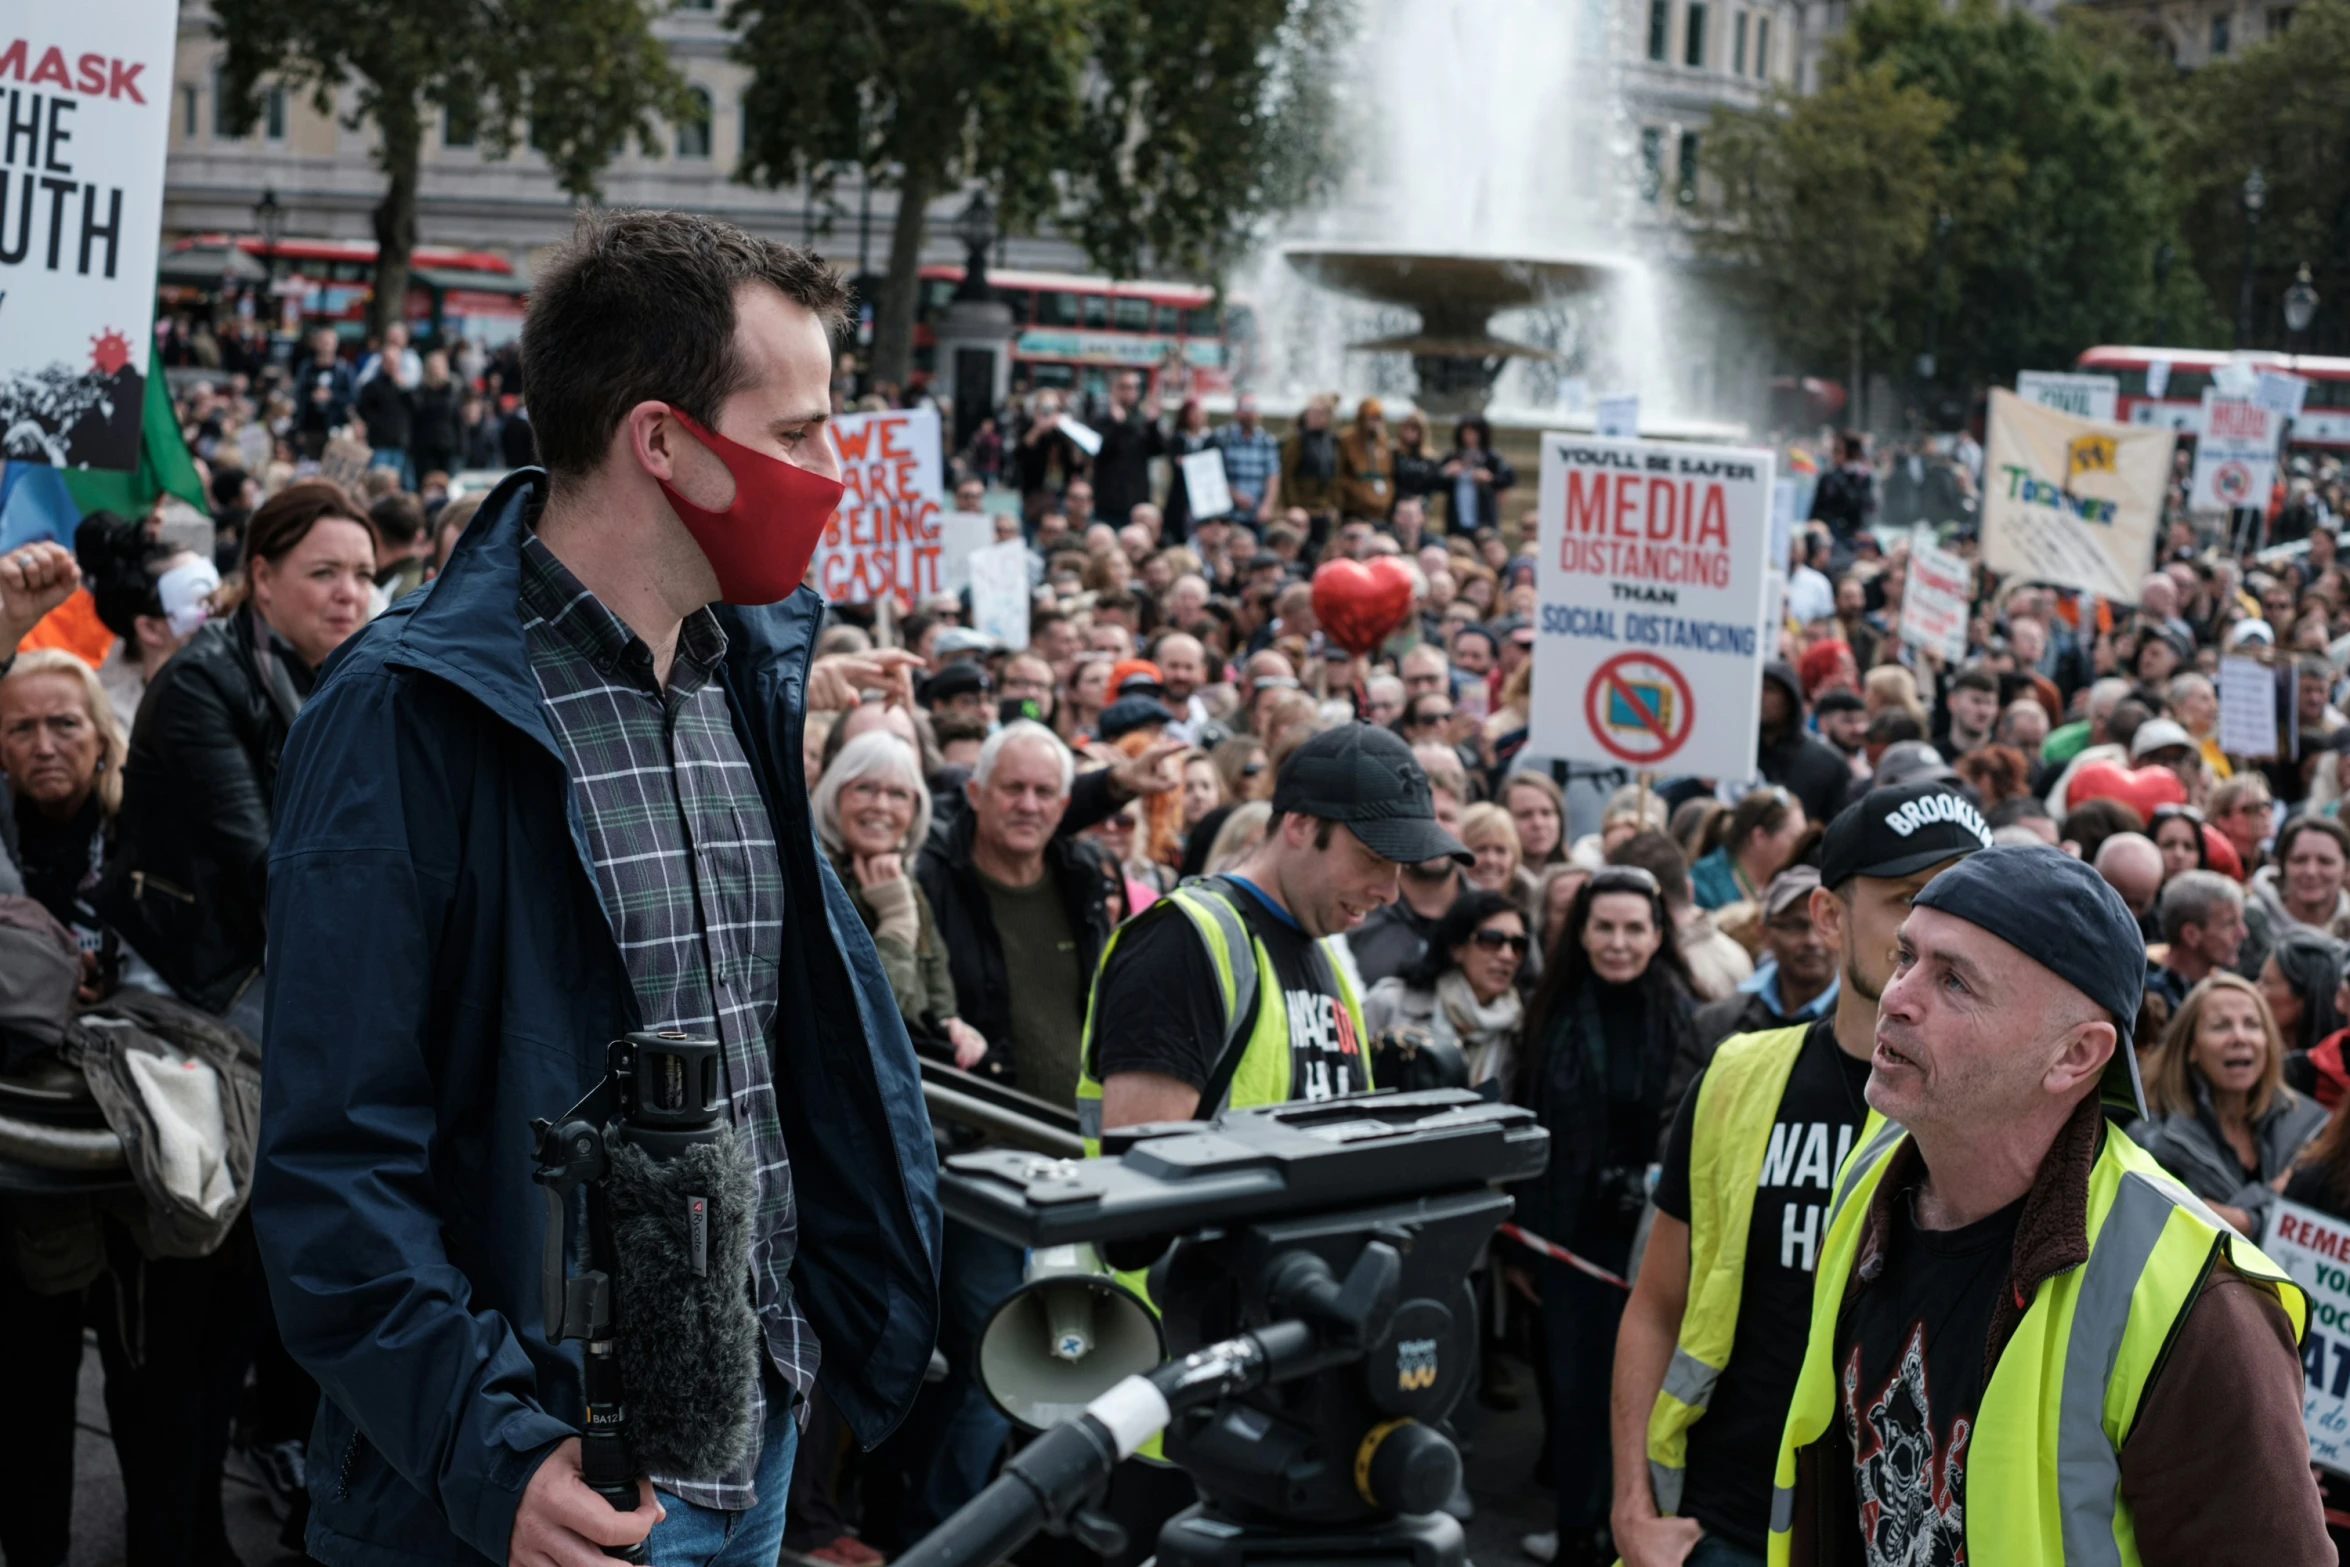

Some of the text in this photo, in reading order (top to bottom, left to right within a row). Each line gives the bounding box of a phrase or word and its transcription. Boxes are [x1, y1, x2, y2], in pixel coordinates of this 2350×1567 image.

[0, 87, 77, 174] HE
[830, 417, 911, 461] WE
[843, 460, 920, 500] ARE
[1646, 454, 1673, 472] BE
[1680, 459, 1756, 481] SAFER
[824, 501, 943, 548] BEING
[1565, 469, 1729, 549] MEDIA
[823, 545, 942, 600] GASLIT
[1560, 536, 1731, 590] DISTANCING
[1611, 583, 1678, 606] THAN
[1542, 604, 1757, 658] SOCIAL DISTANCING
[692, 1213, 703, 1252] Rycote
